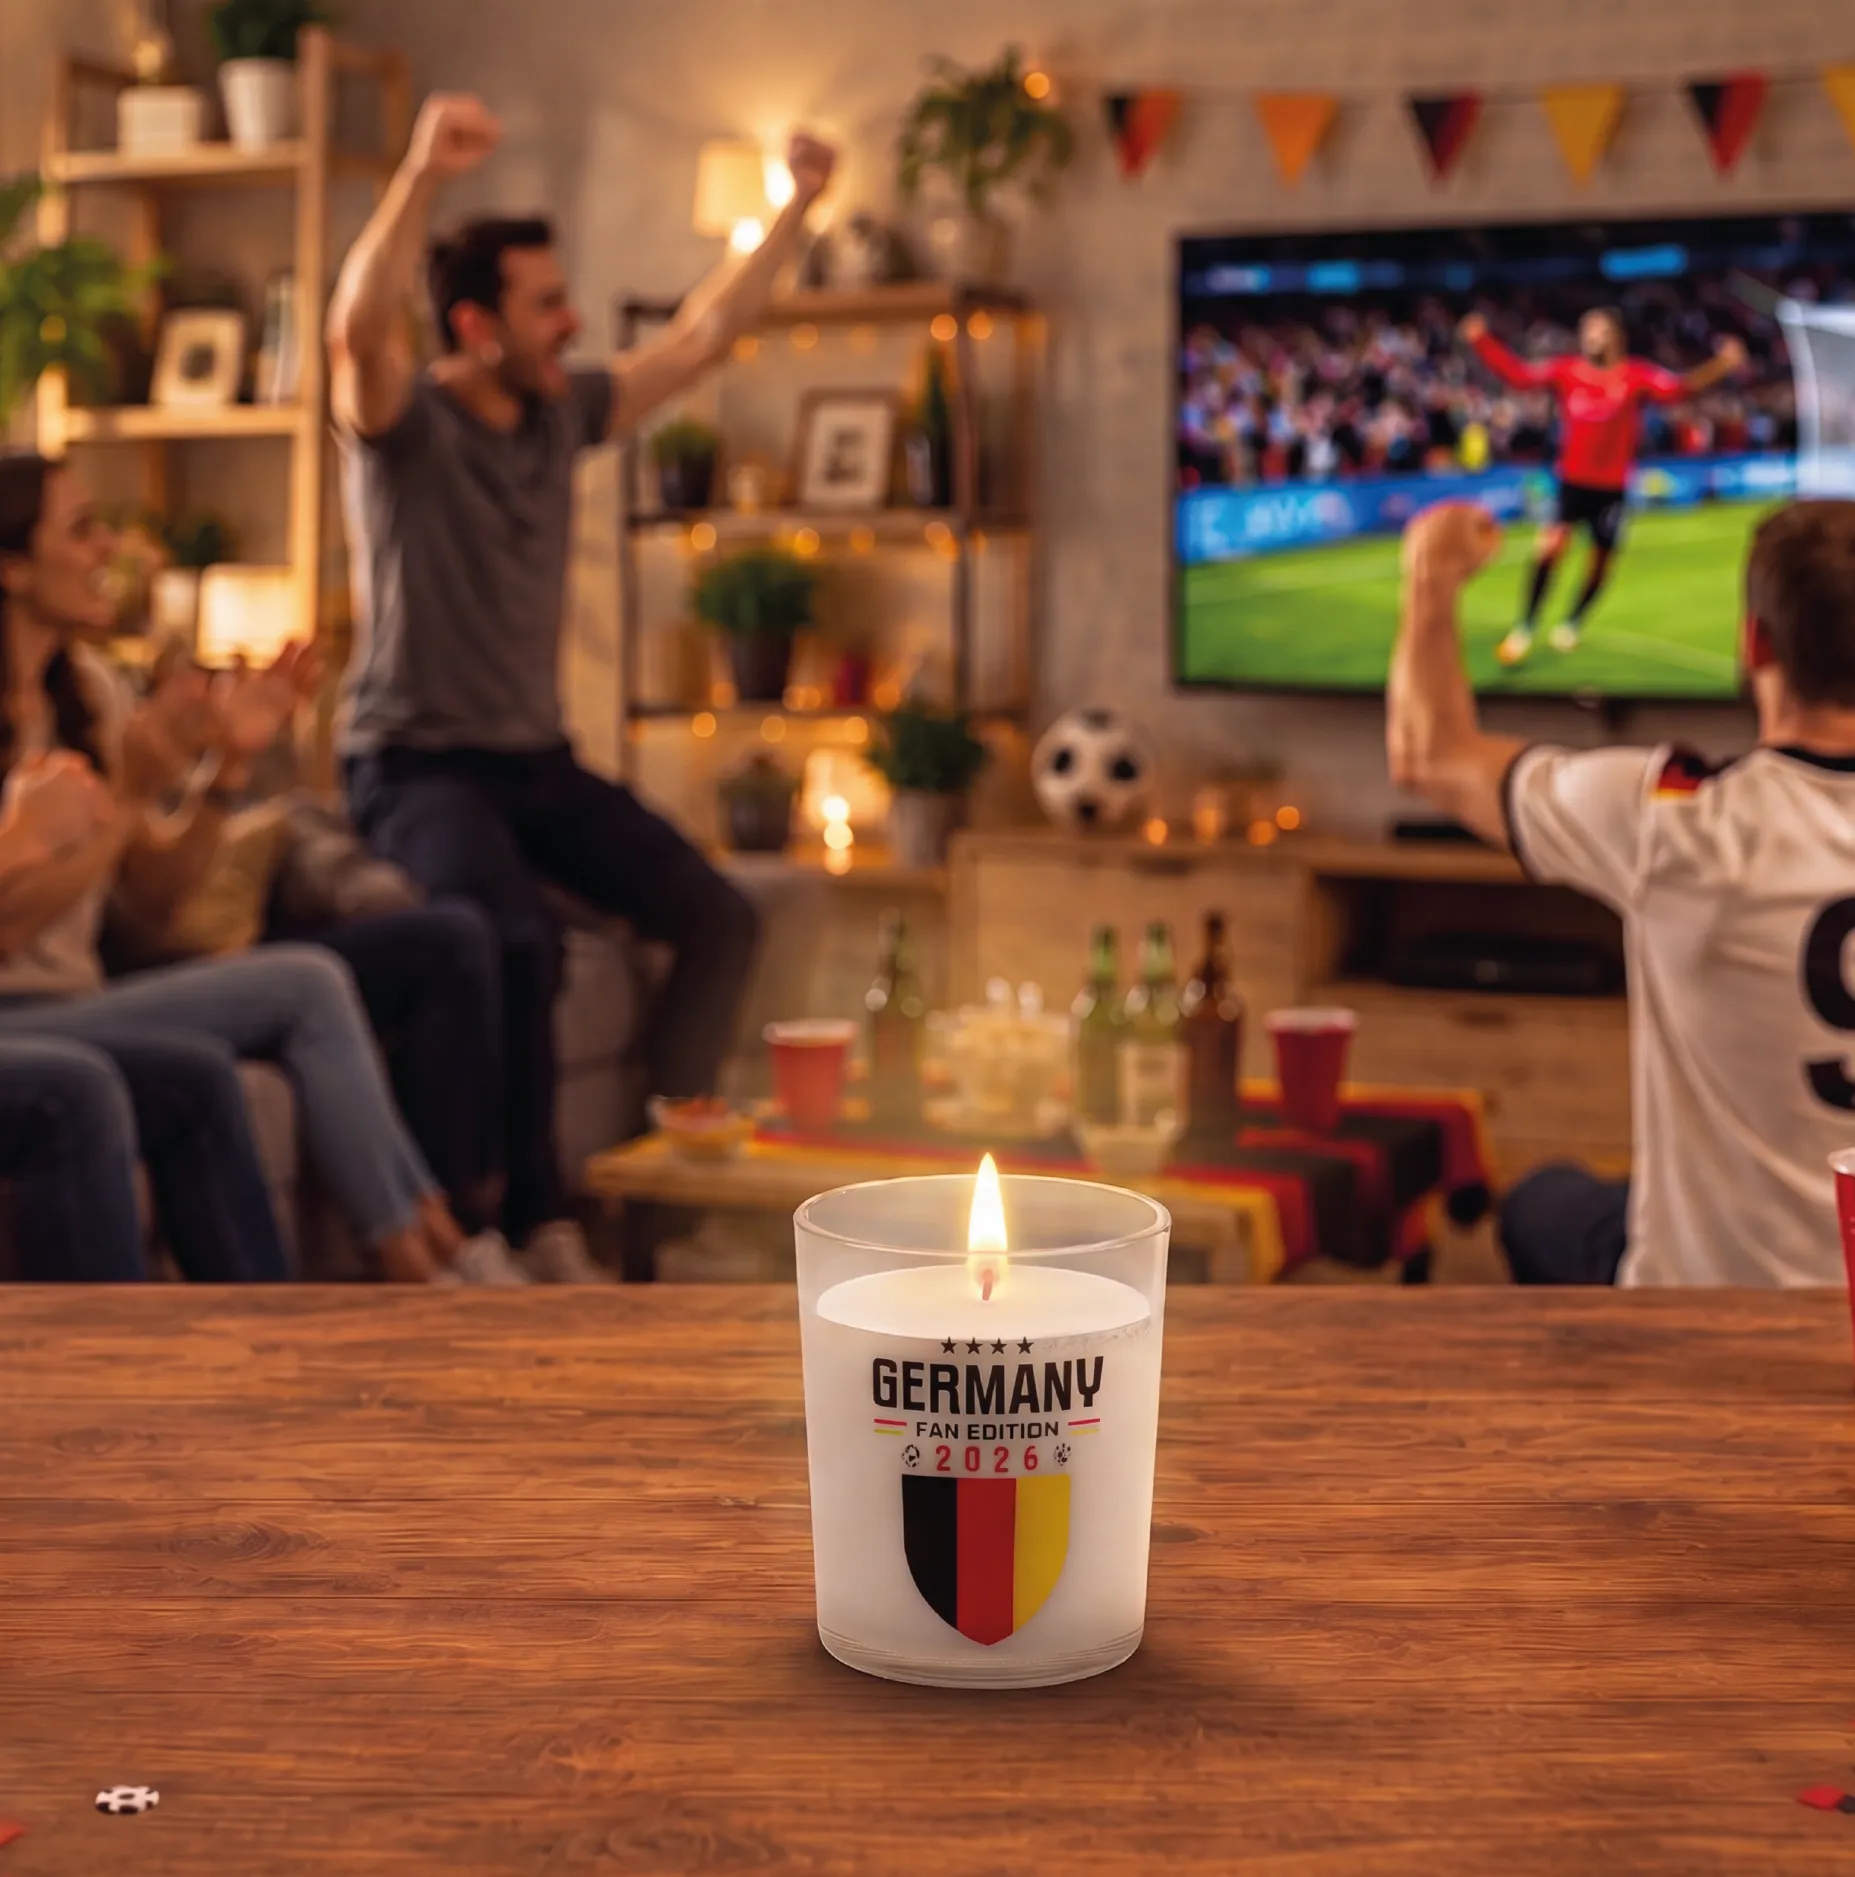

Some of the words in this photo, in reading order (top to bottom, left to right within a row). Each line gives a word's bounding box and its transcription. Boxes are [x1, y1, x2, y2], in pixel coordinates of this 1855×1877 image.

[872, 1356, 1104, 1415] GERMANY
[916, 1421, 959, 1439] FAN
[967, 1421, 1059, 1440] EDITION
[935, 1445, 1038, 1473] 2026
